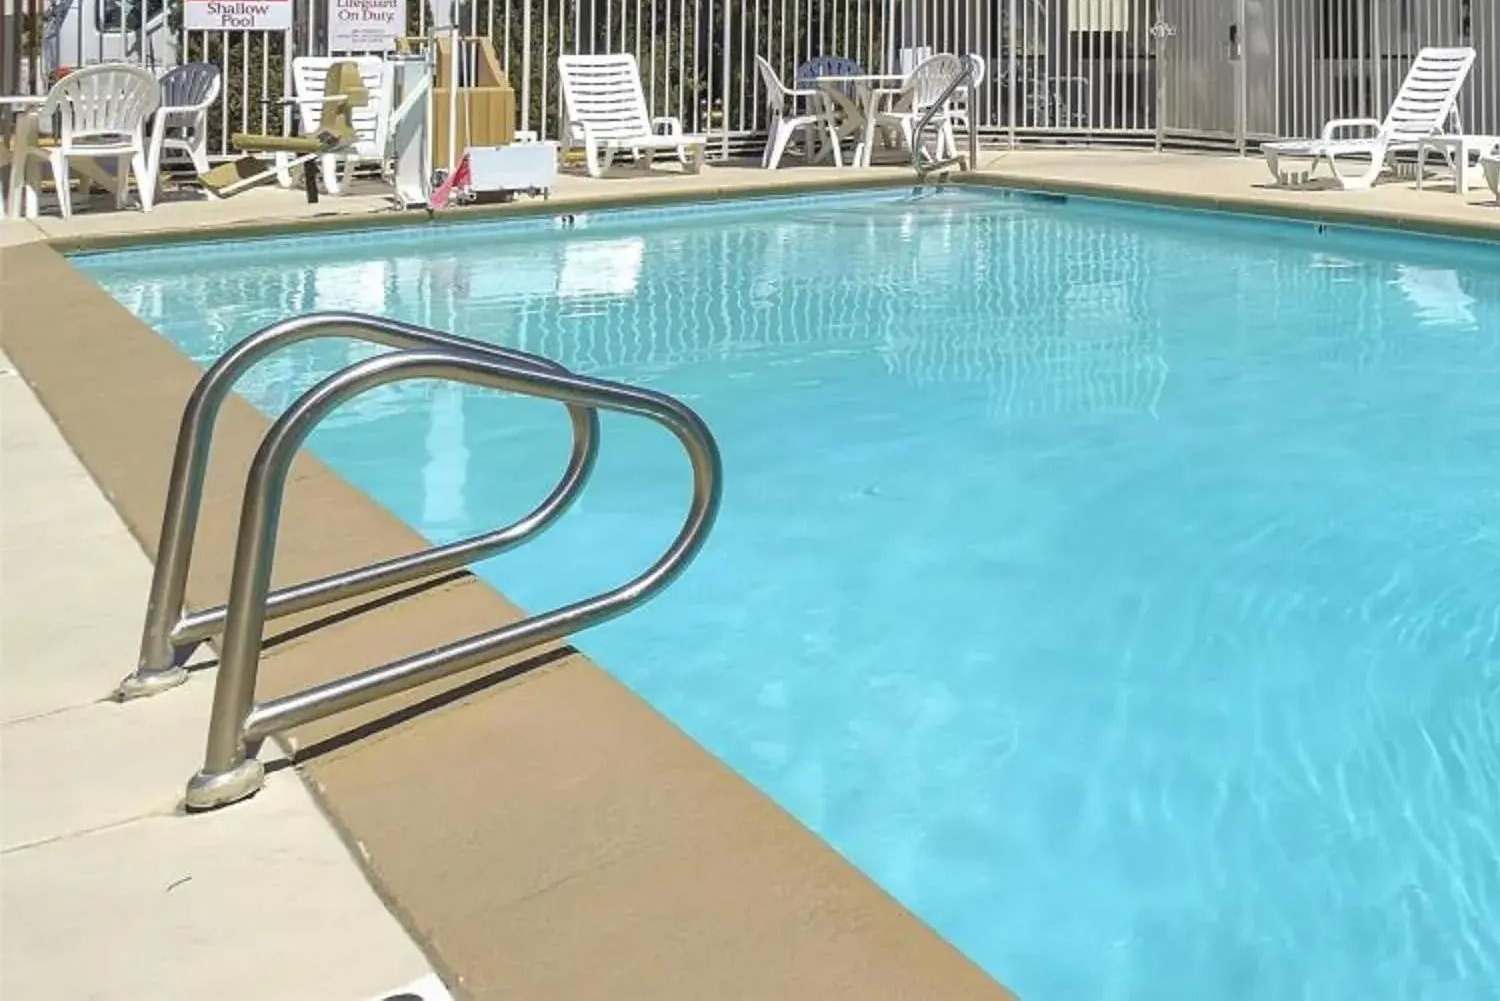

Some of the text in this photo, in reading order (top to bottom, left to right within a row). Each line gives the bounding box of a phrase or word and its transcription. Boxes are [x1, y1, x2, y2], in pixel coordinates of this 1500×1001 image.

[207, 2, 269, 15] Shallow
[337, 9, 359, 20] On
[221, 14, 255, 27] Pool
